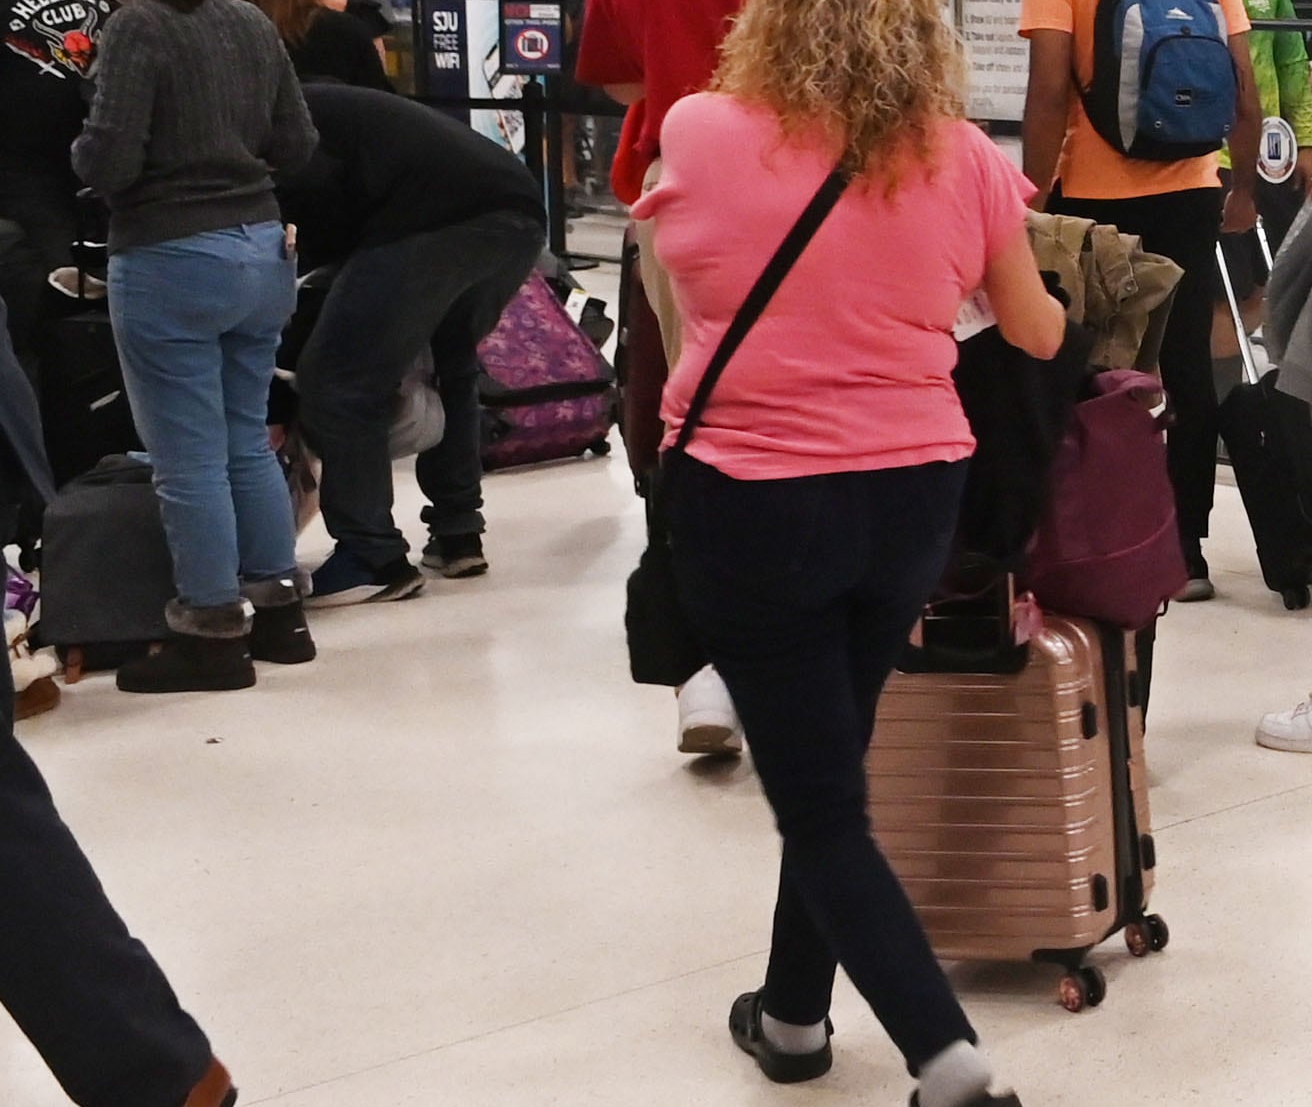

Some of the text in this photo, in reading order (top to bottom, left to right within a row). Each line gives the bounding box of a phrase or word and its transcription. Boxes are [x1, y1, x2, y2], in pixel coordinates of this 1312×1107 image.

[41, 3, 88, 25] CLUB
[432, 10, 459, 32] SJU
[432, 33, 459, 51] FREE
